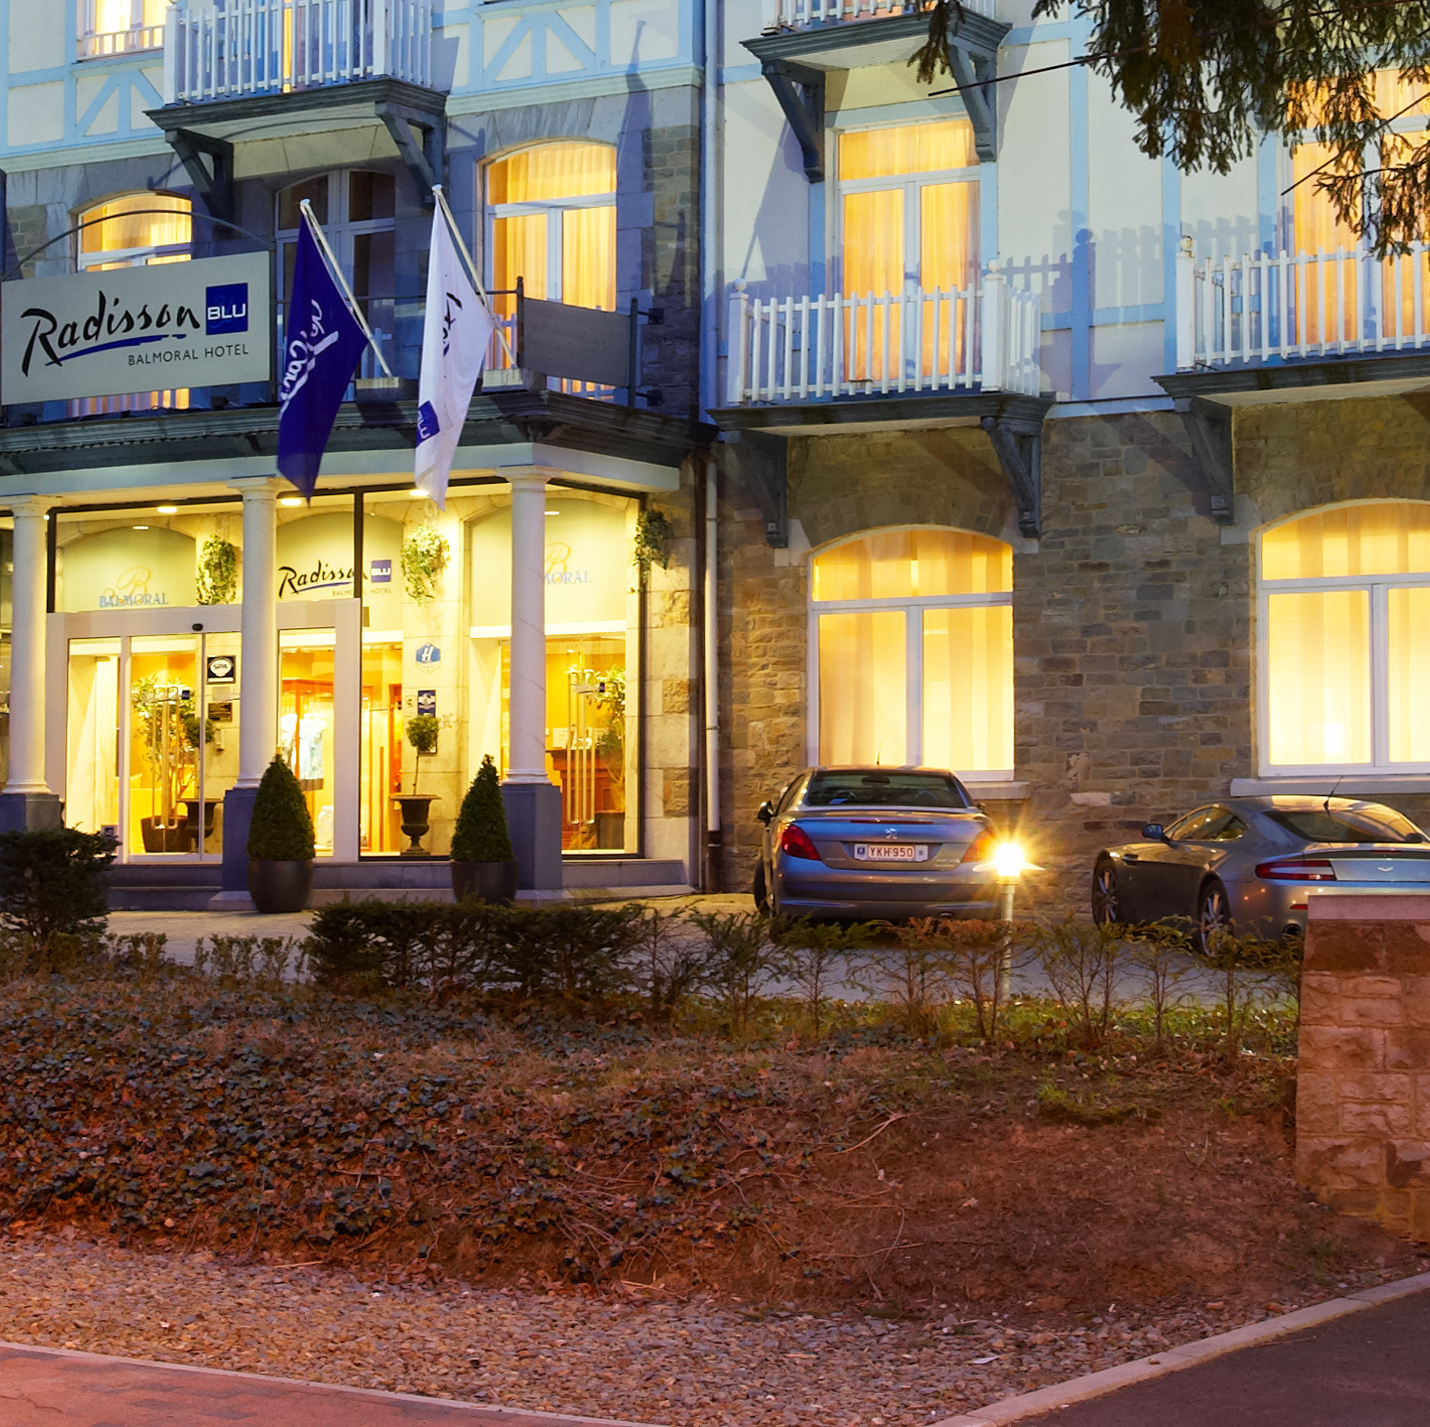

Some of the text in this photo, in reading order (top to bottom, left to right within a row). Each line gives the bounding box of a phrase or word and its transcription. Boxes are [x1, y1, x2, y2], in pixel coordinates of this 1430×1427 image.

[20, 290, 247, 377] Radisson BLU
[128, 343, 249, 366] BALMORAL HOTEL
[278, 559, 368, 599] Radisso
[99, 592, 169, 608] BALMORAL
